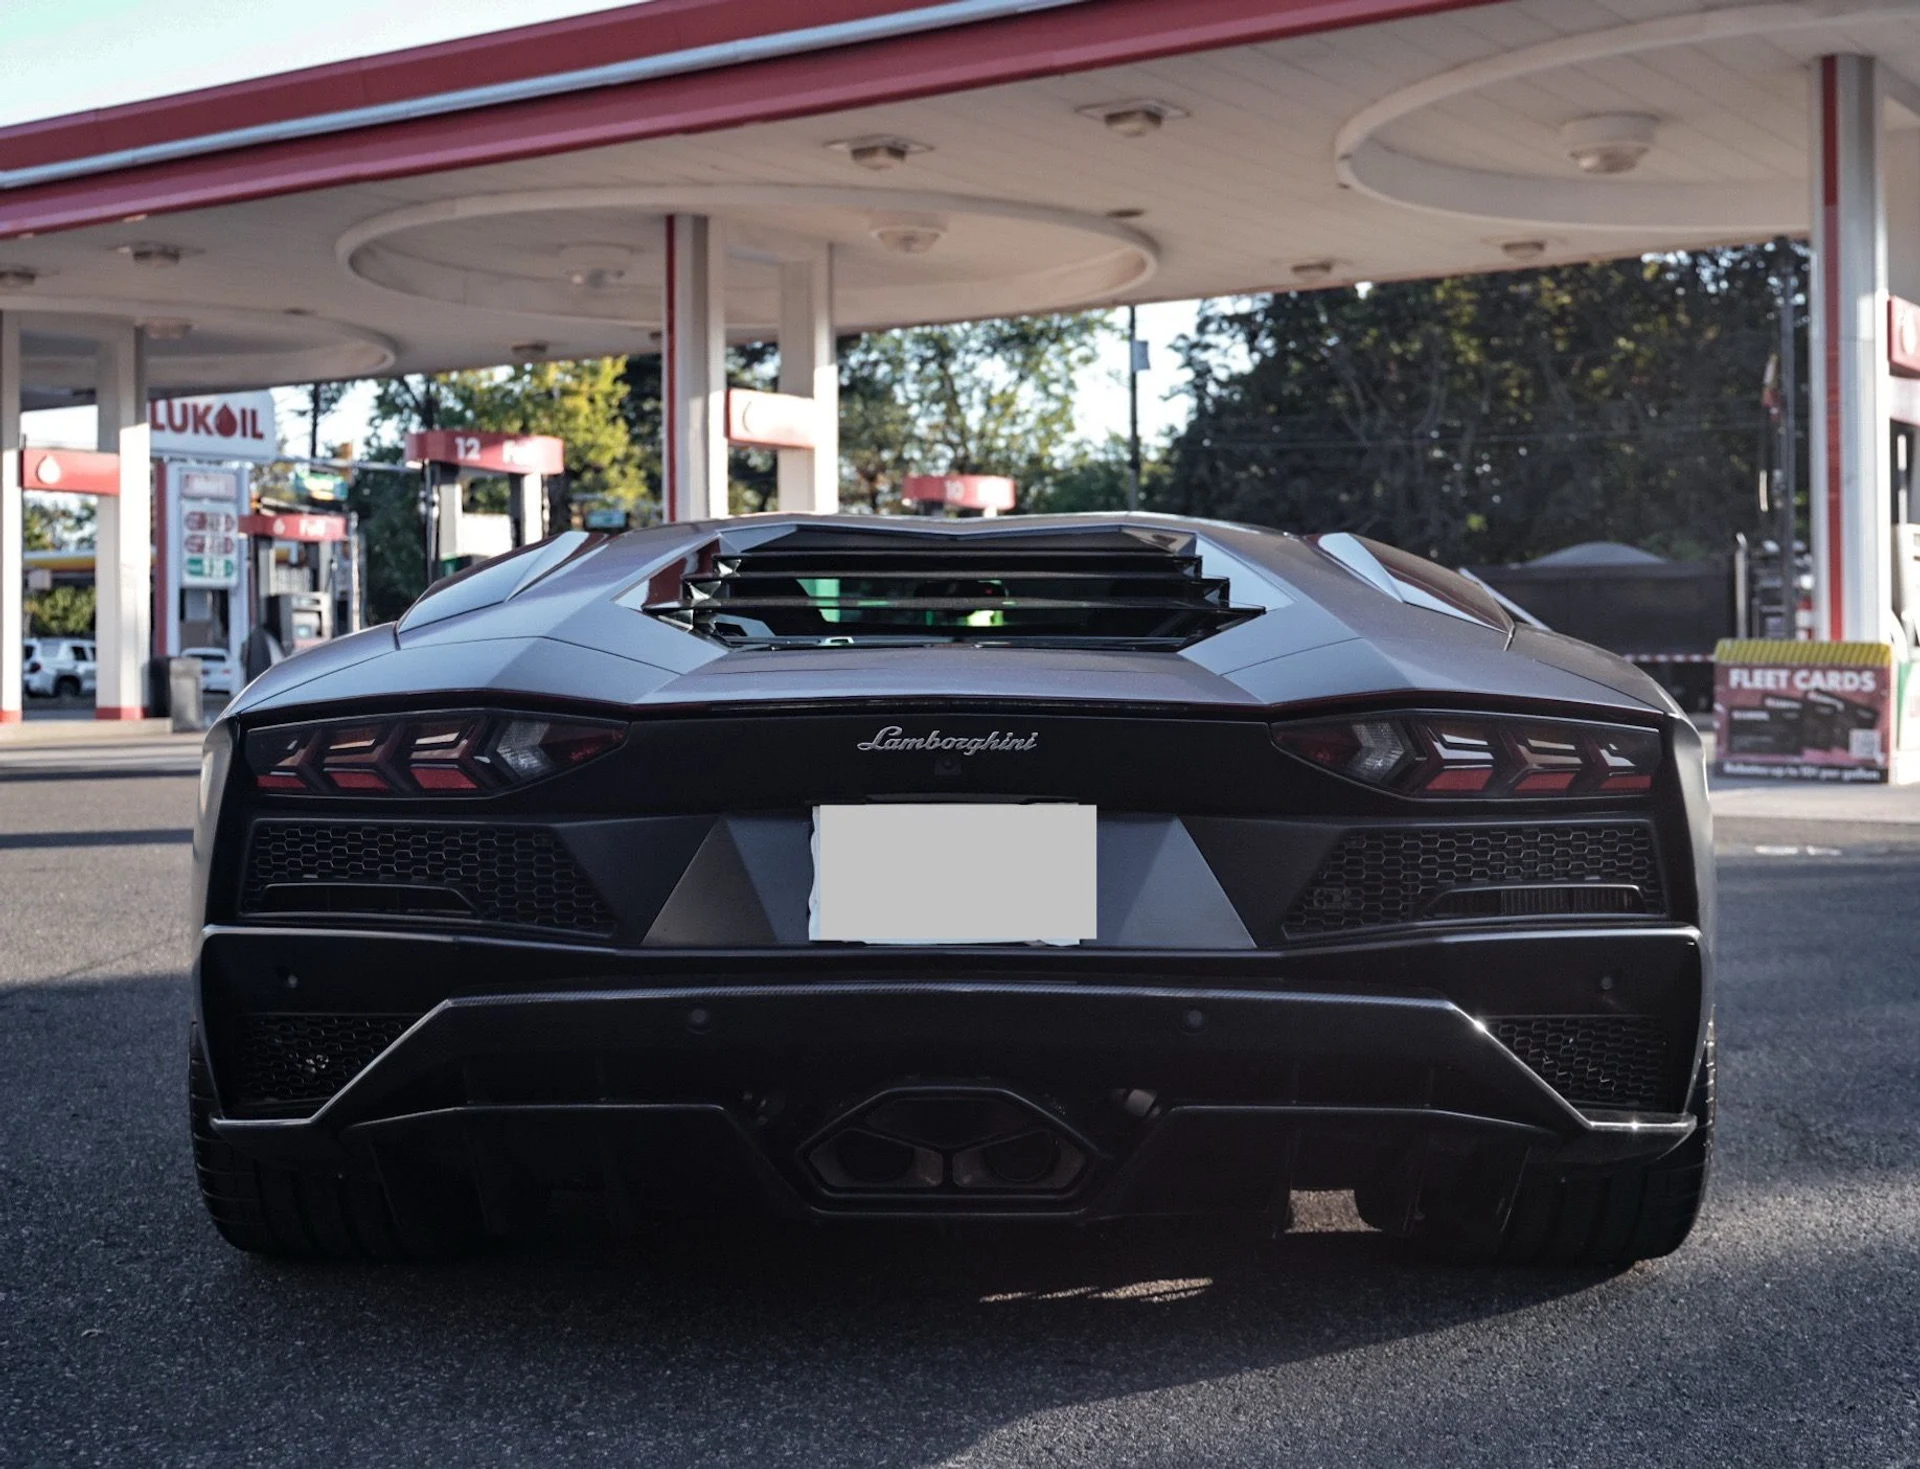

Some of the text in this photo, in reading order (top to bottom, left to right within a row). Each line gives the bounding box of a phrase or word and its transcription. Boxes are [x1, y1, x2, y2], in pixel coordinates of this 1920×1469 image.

[150, 399, 264, 439] LUKOIL
[455, 437, 481, 461] 12
[1728, 667, 1877, 692] FLEET CARDS
[856, 726, 1039, 756] Lamborghini
